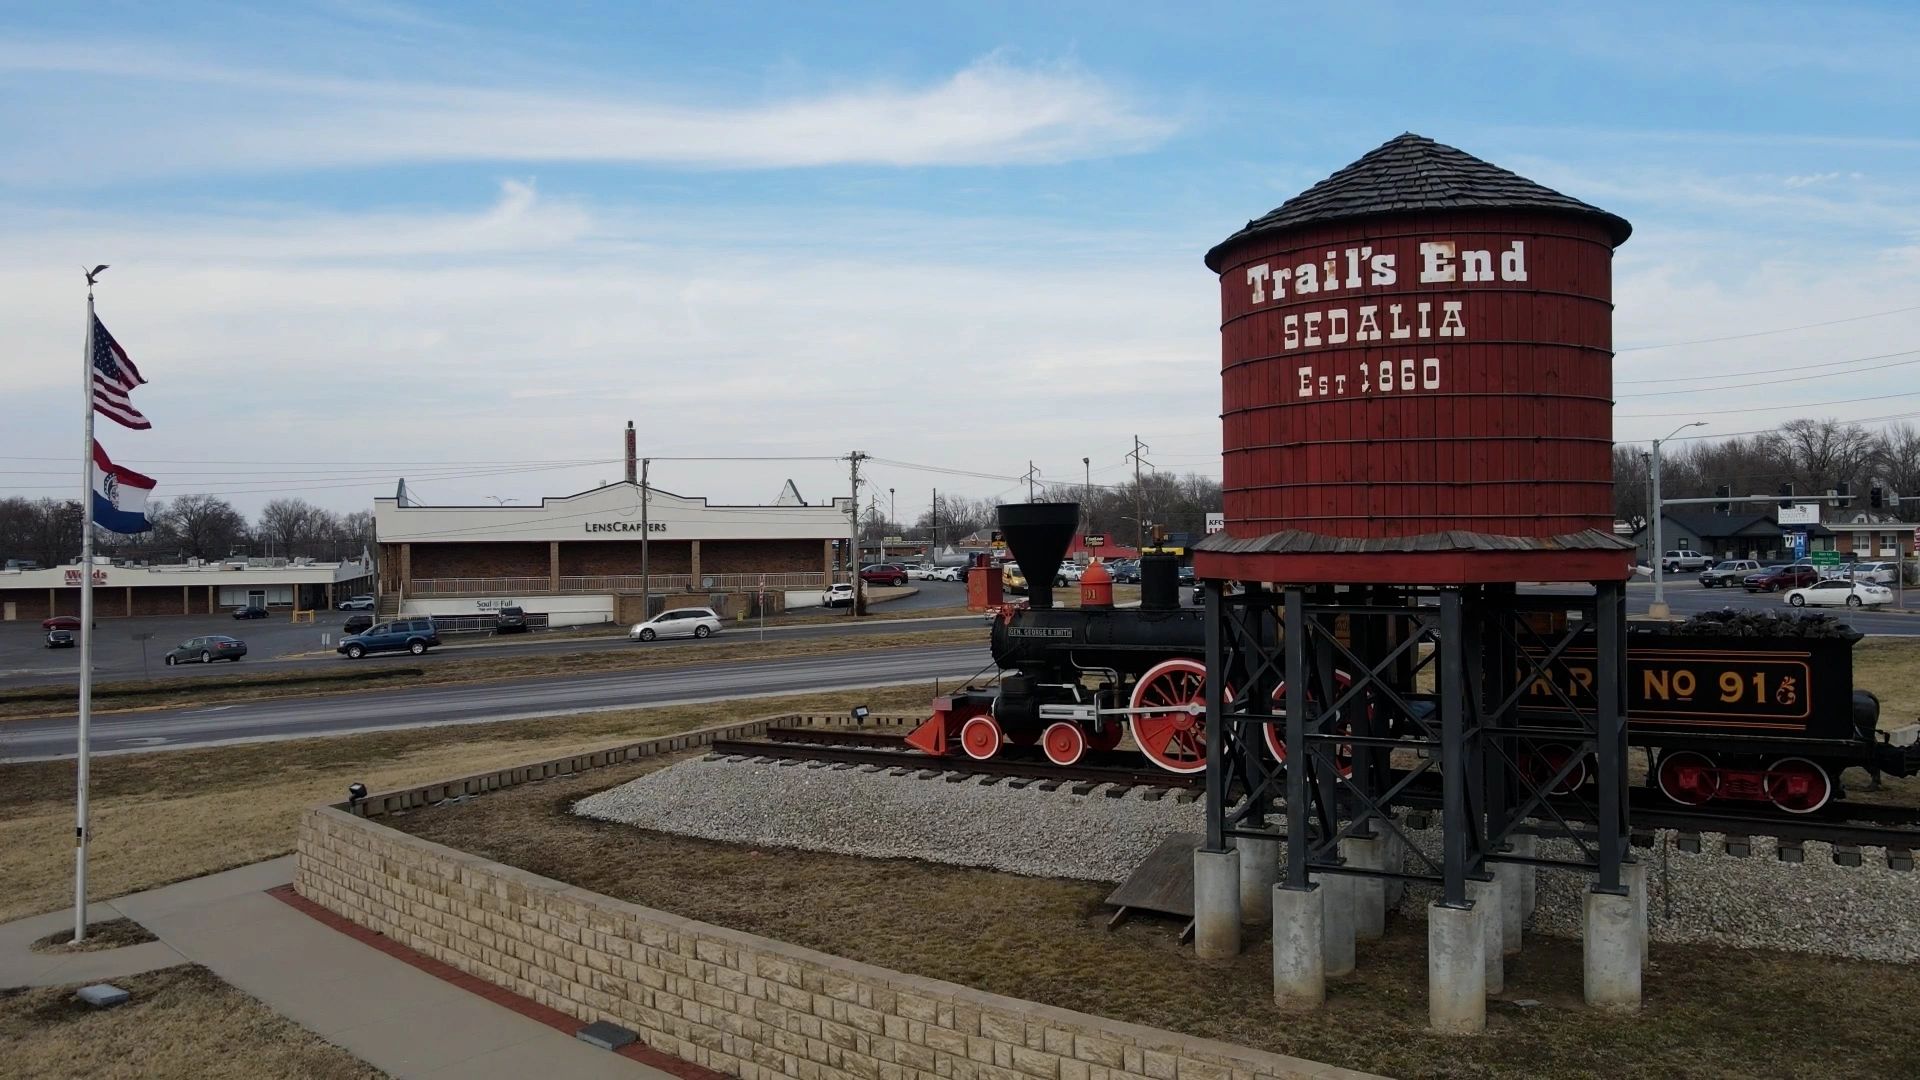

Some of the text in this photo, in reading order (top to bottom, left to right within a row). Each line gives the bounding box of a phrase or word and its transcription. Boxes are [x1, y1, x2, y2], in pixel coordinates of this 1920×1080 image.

[1247, 241, 1527, 304] Trail's End
[1284, 301, 1466, 349] SEDALIA
[1360, 358, 1440, 393] 1860
[585, 521, 667, 532] LENSCRAFERS
[64, 569, 108, 579] Wds
[476, 600, 492, 608] Soul
[1023, 628, 1047, 636] GEORGE
[1053, 629, 1071, 637] SMITH
[1719, 671, 1767, 703] 91
